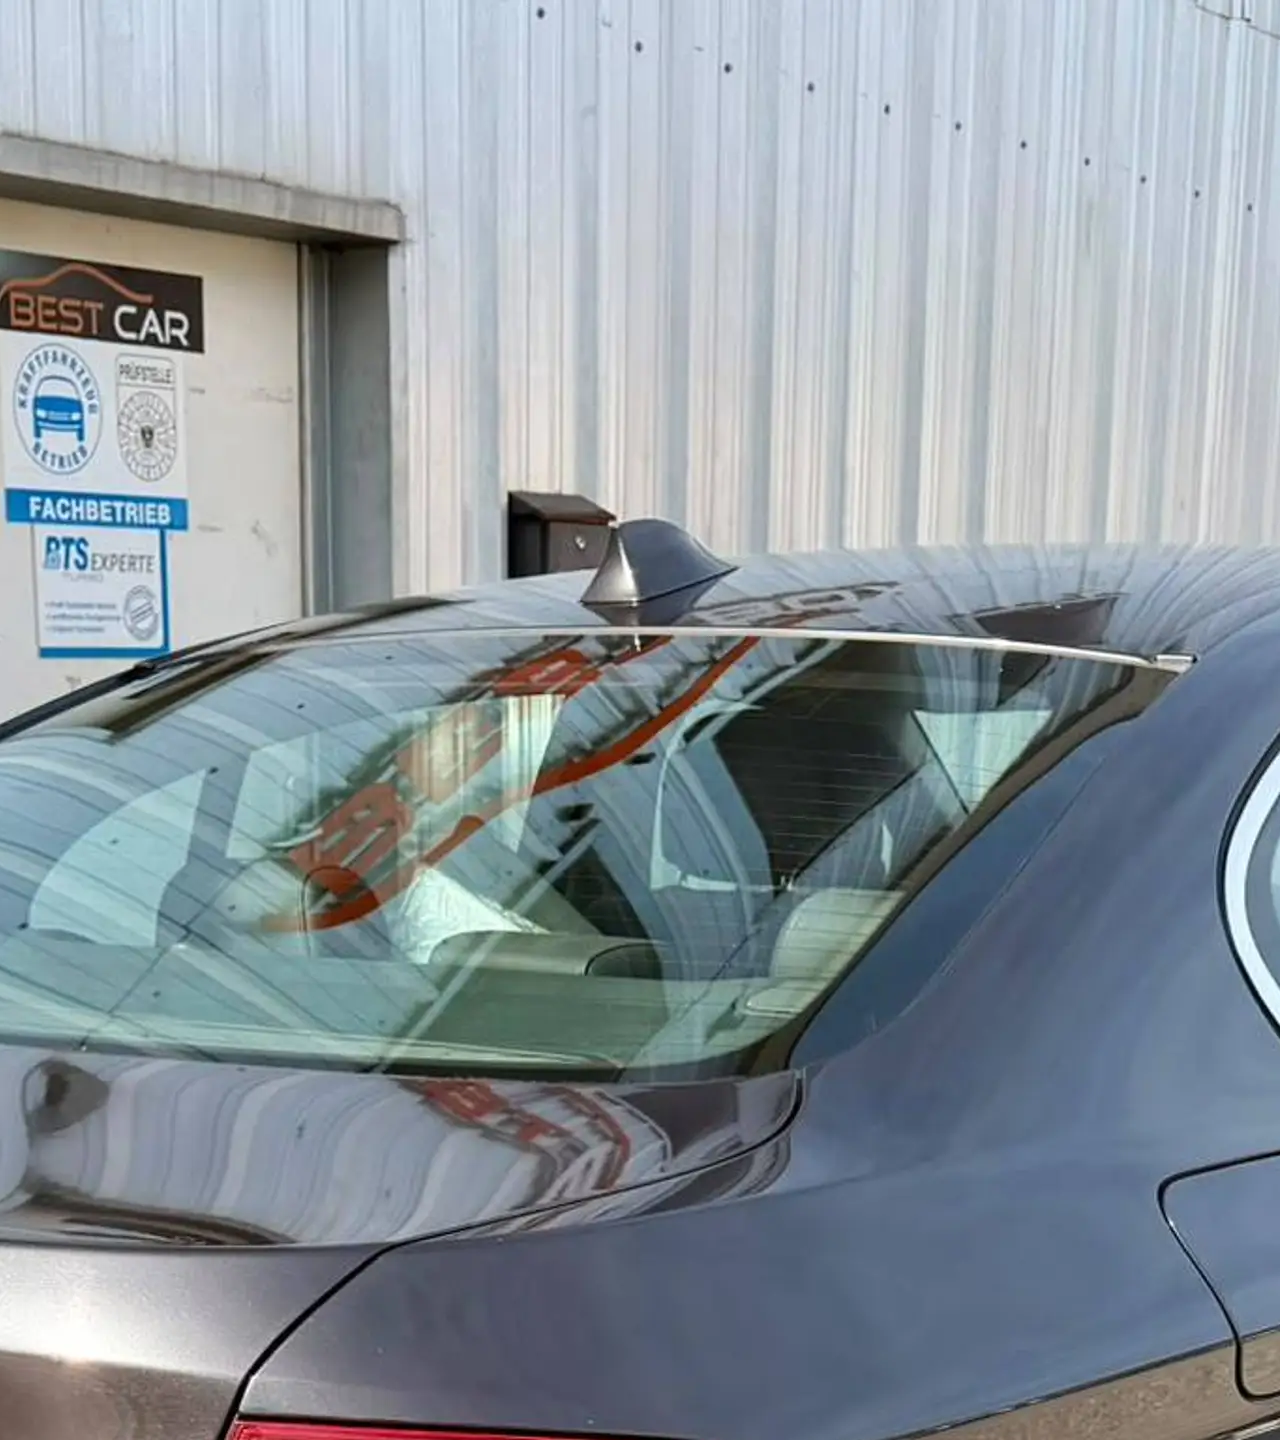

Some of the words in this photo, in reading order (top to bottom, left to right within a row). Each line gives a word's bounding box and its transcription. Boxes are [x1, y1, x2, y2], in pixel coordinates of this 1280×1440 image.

[9, 293, 104, 335] BEST
[114, 305, 190, 347] CAR
[29, 496, 171, 525] FACHBETRIEB
[91, 553, 155, 574] EXPERTE
